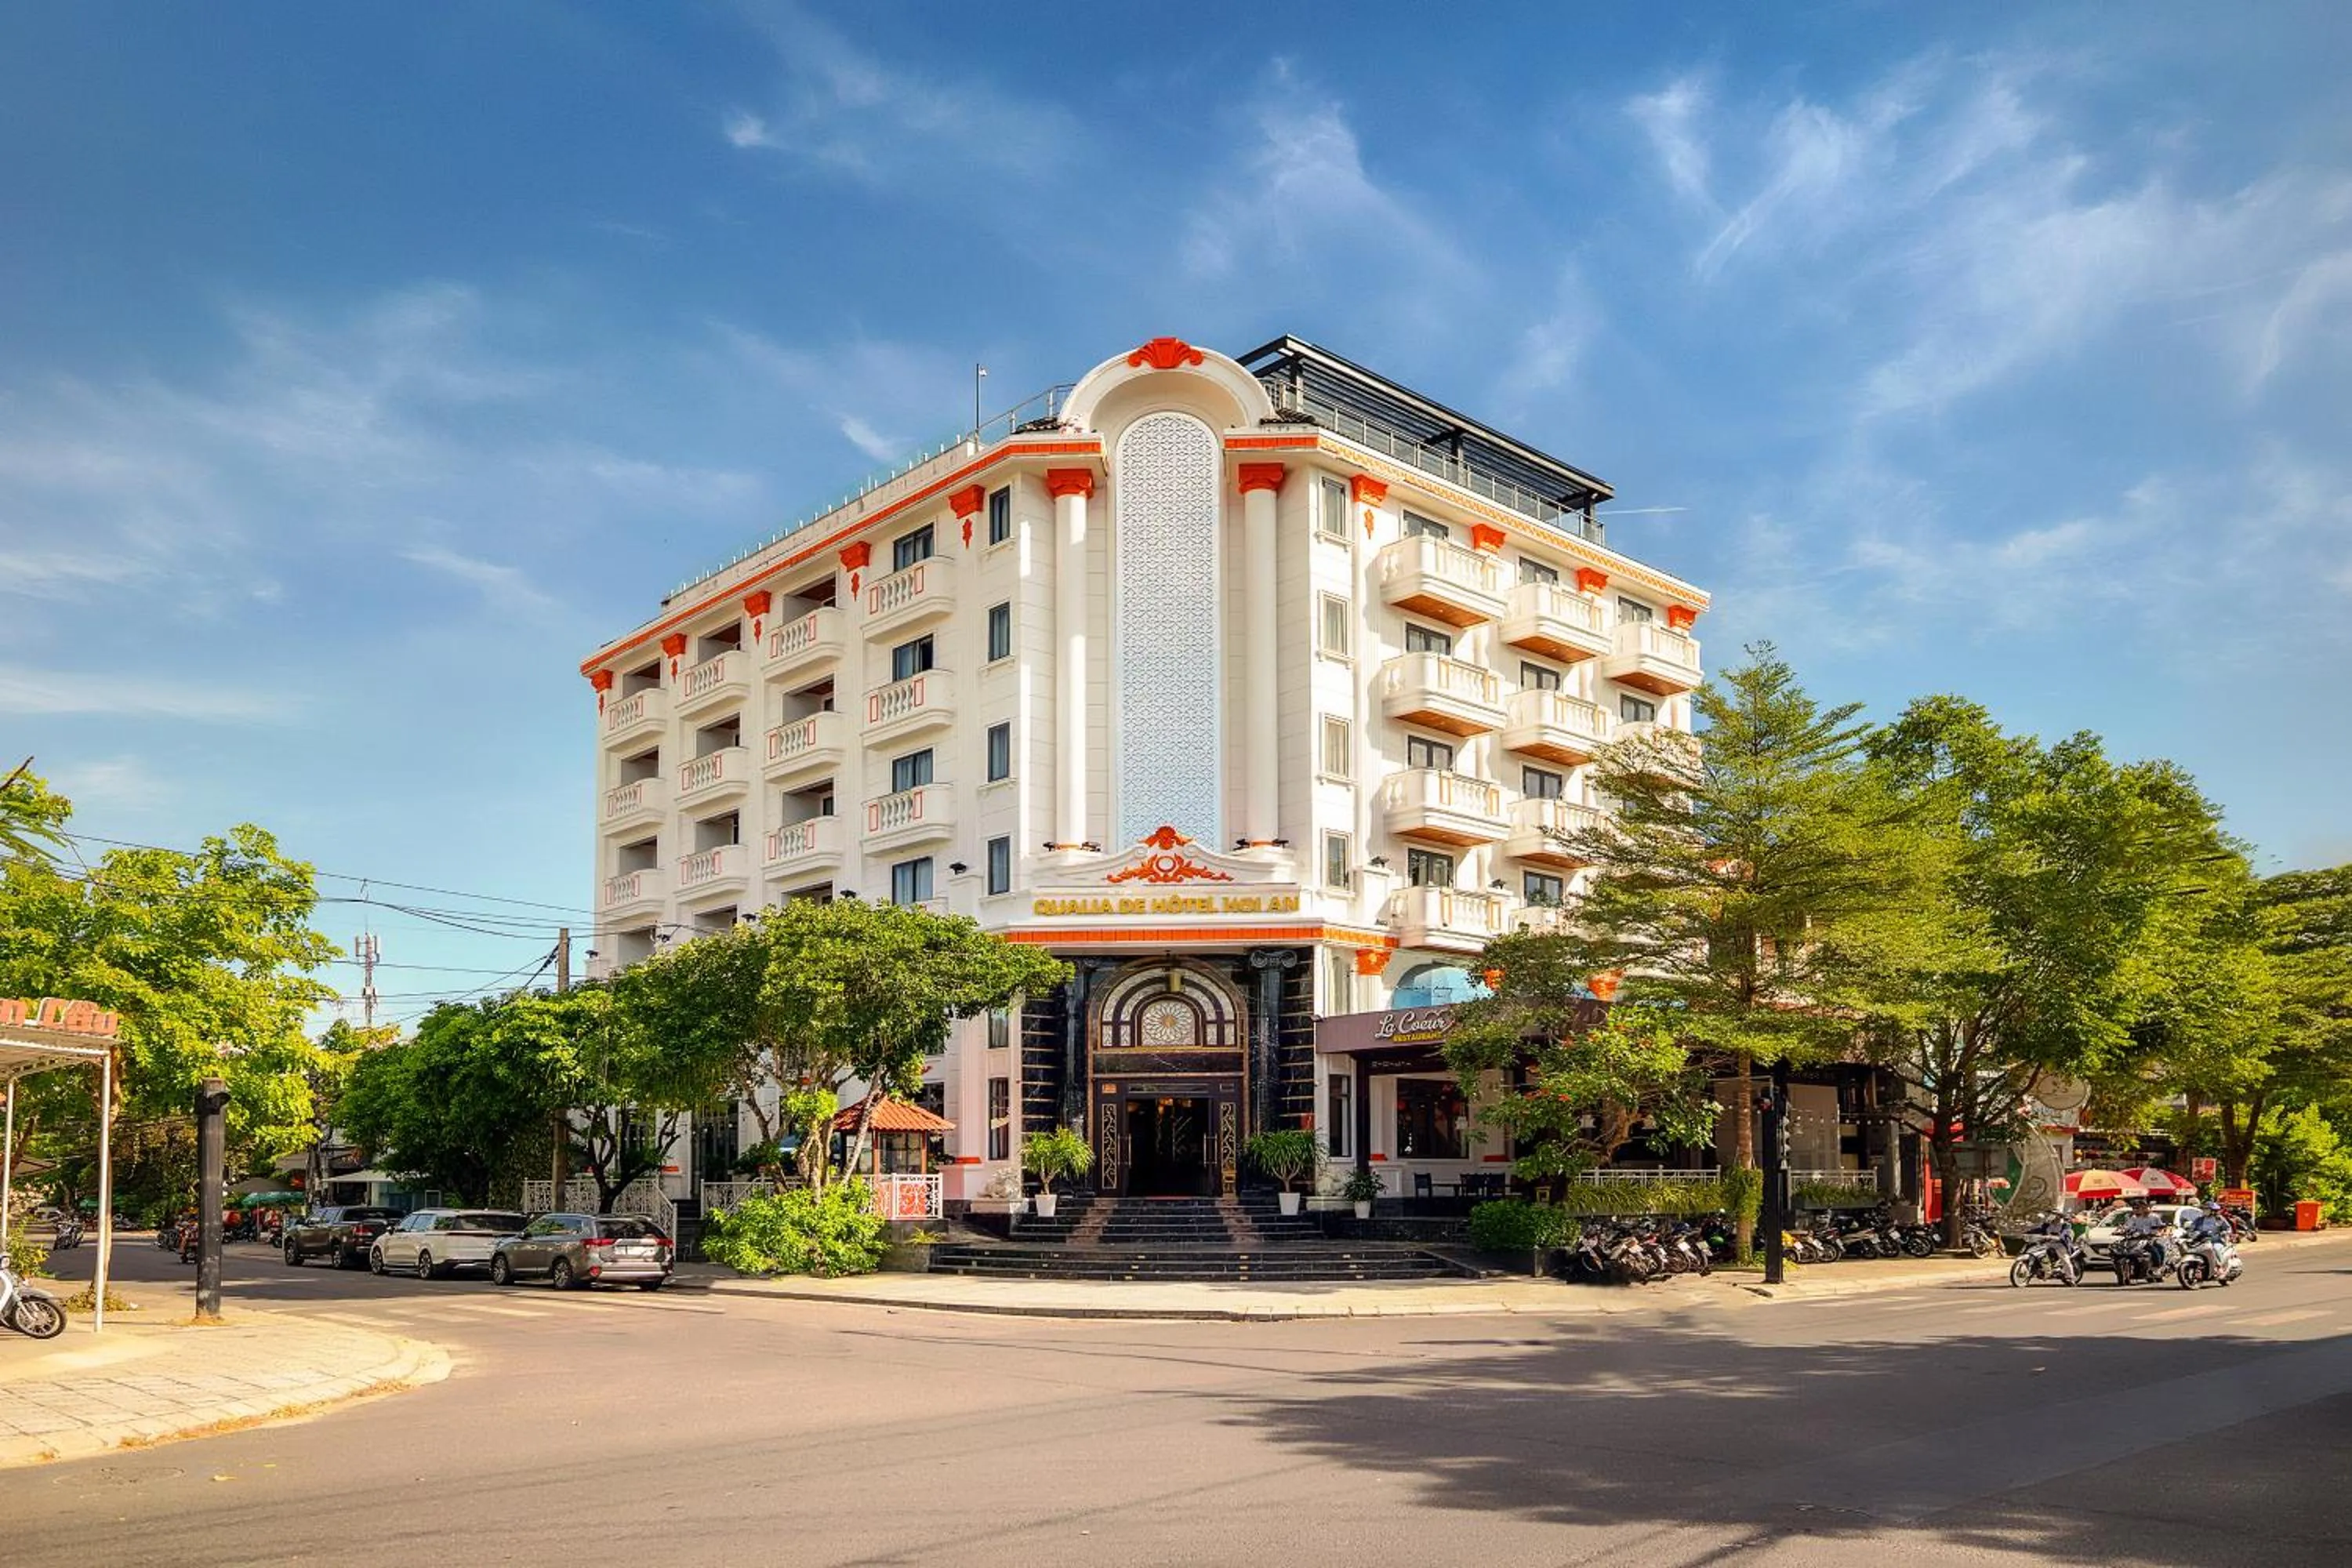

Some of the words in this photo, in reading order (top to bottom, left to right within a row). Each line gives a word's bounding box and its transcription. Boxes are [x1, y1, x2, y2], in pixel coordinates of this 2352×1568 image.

[1034, 898, 1114, 916] QUALIA
[1119, 898, 1145, 915] DE
[1267, 896, 1299, 913] AN
[1374, 1014, 1396, 1038] La
[1399, 1011, 1449, 1033] Coeur
